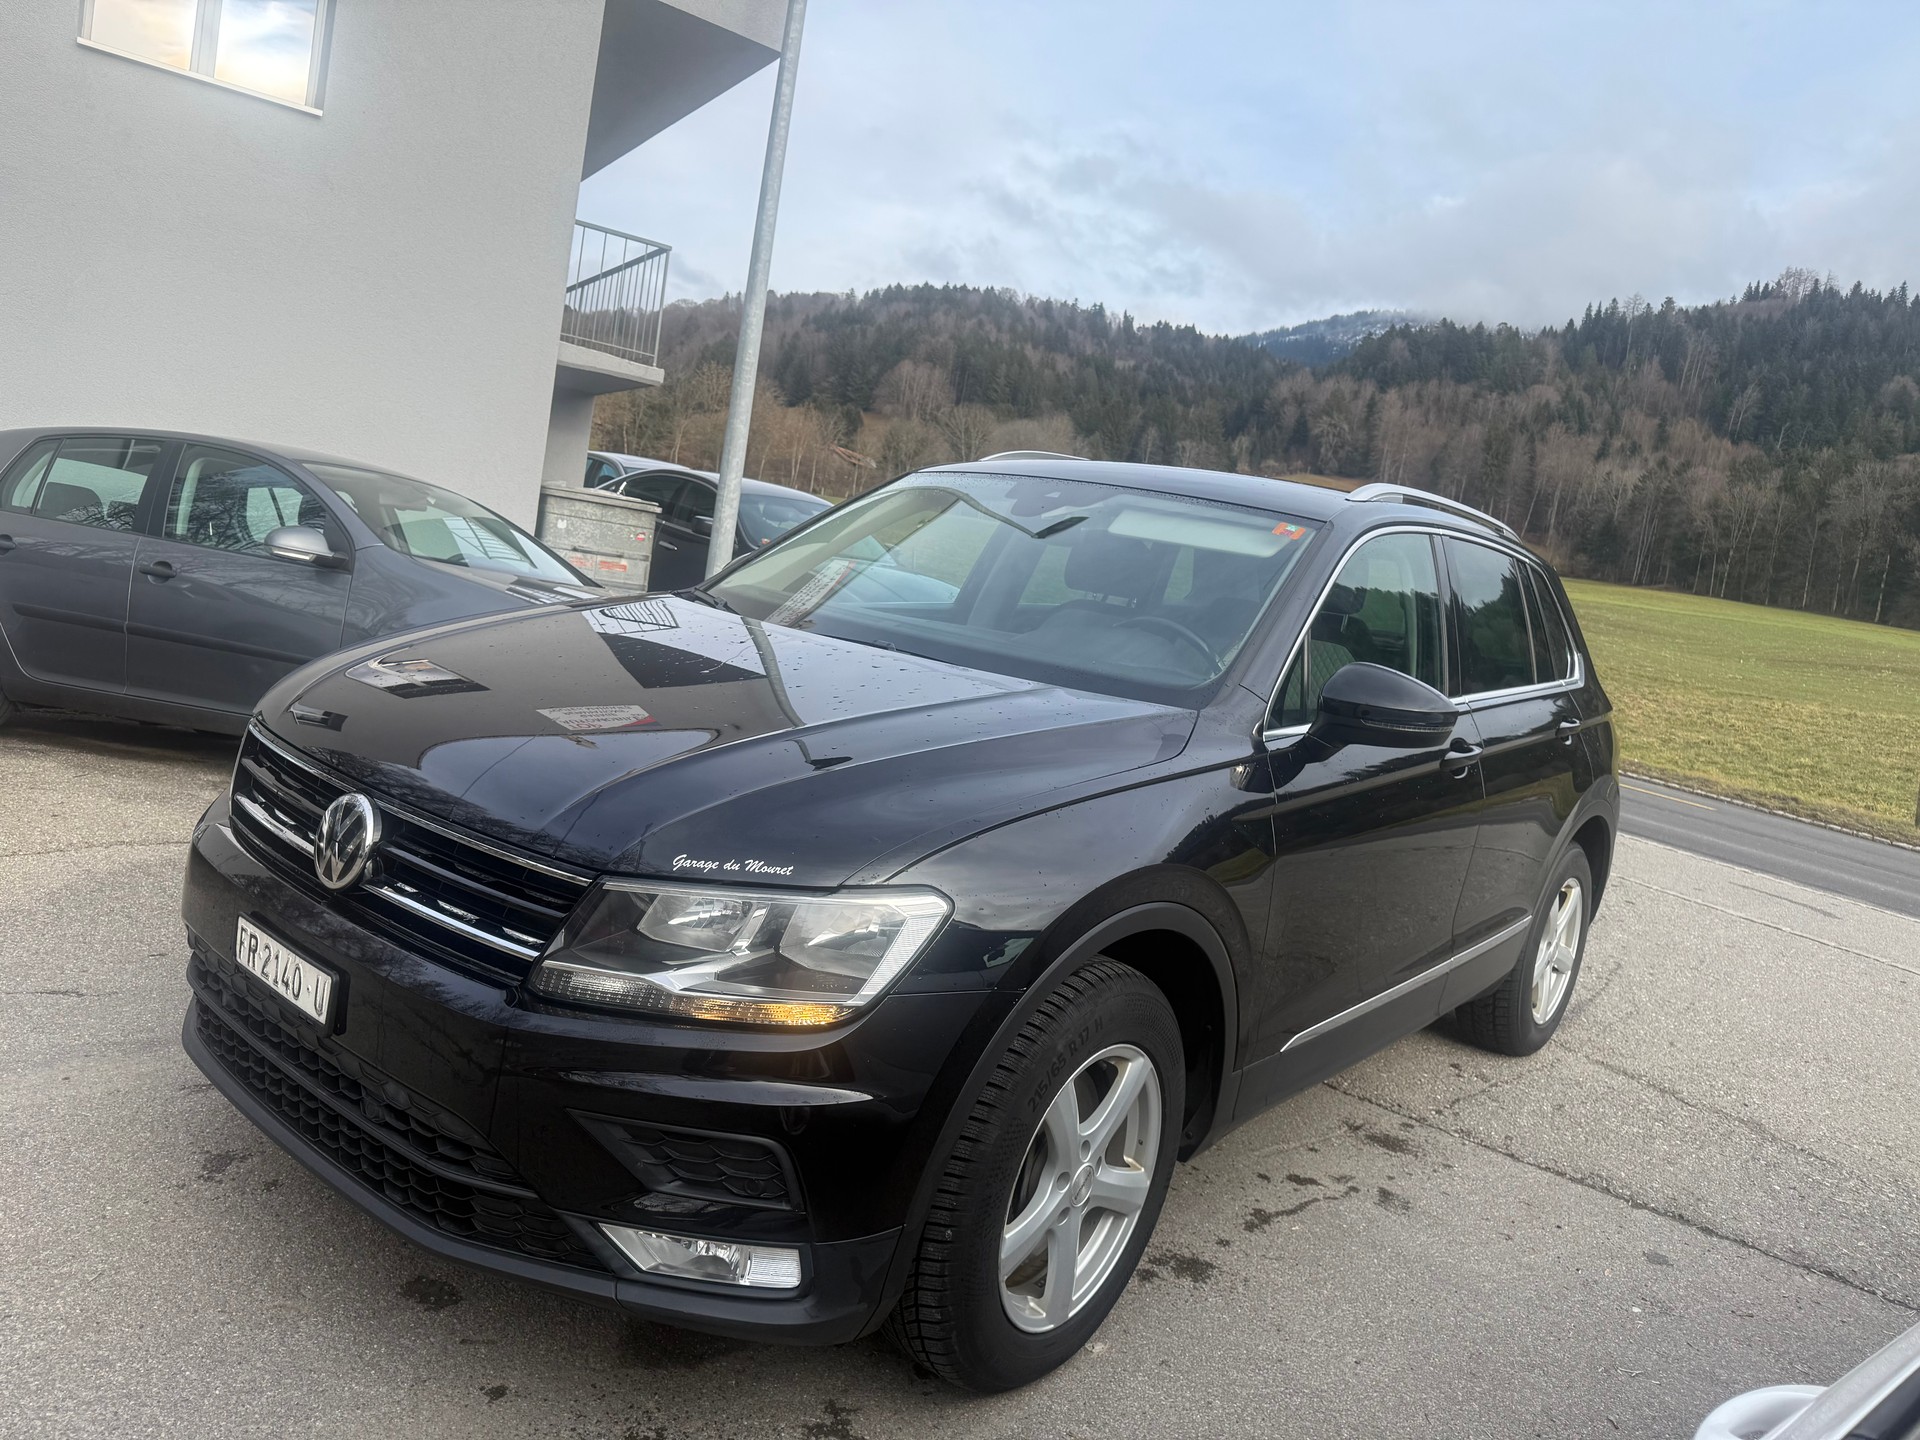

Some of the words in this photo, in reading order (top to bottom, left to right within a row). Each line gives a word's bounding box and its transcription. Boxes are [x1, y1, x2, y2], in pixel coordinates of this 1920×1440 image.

[672, 854, 720, 873] Garage
[723, 859, 741, 871] du
[744, 859, 794, 876] Mouret
[1027, 1051, 1067, 1113] 215/65
